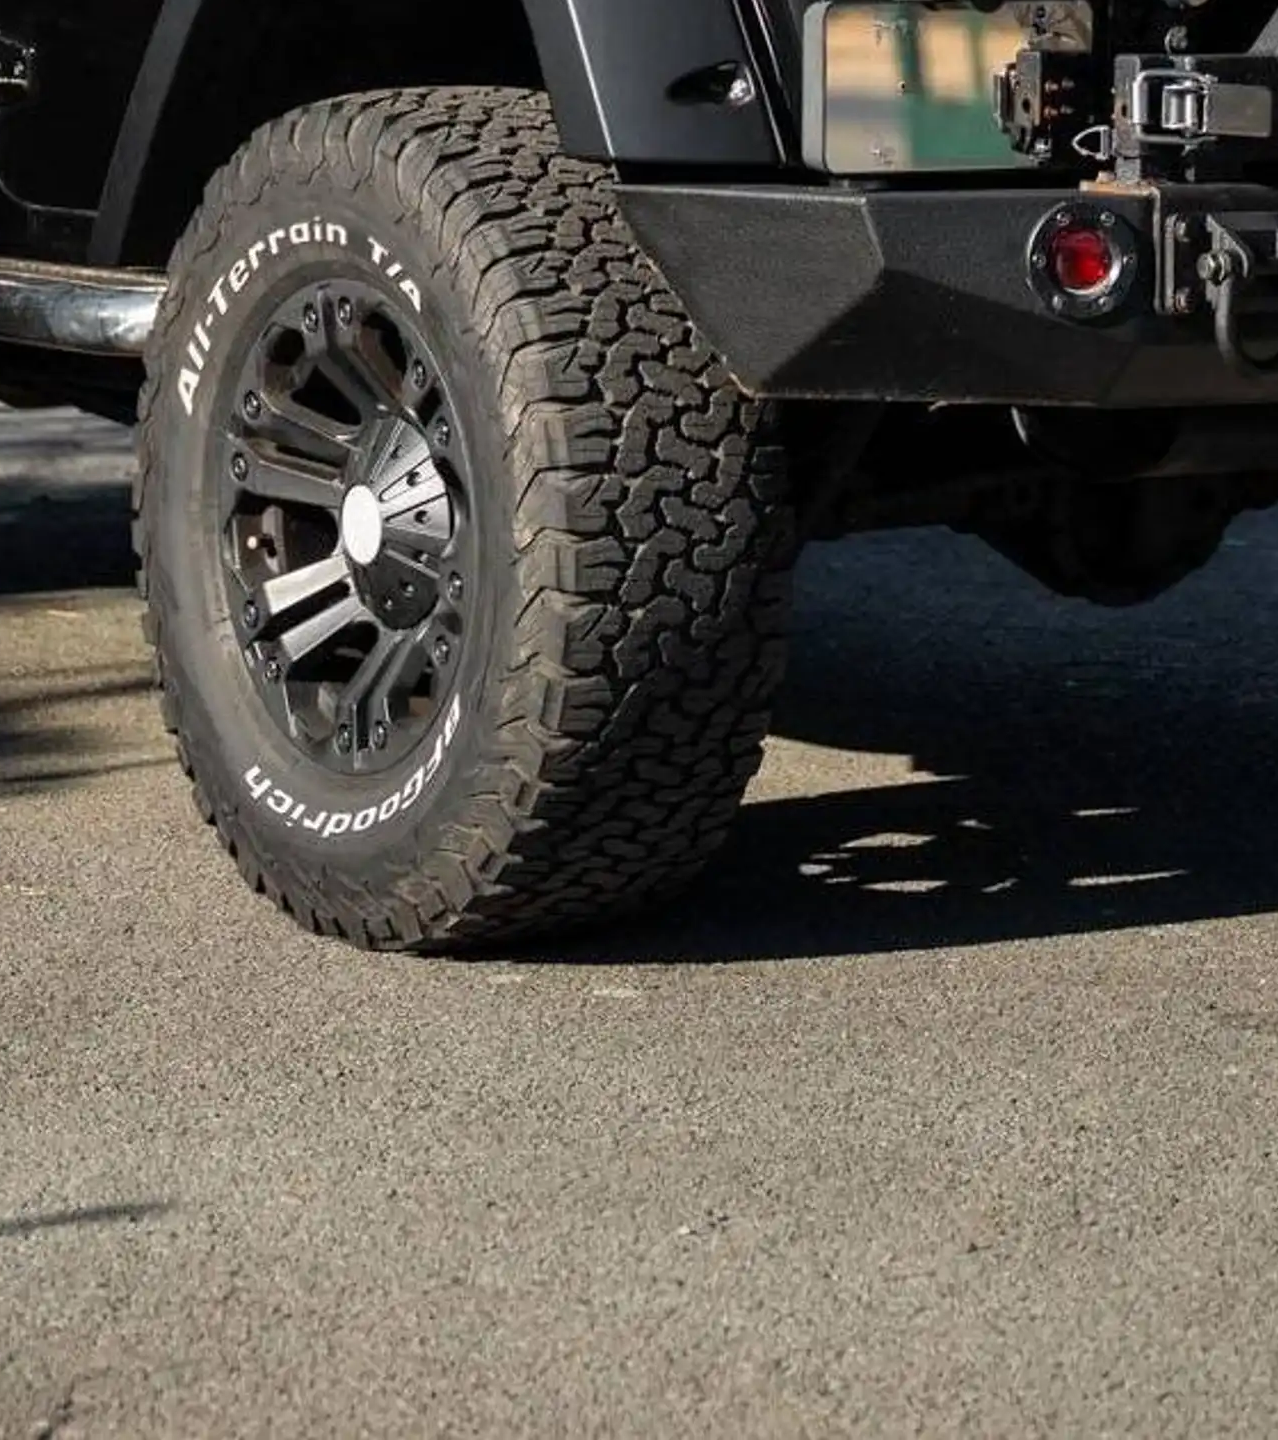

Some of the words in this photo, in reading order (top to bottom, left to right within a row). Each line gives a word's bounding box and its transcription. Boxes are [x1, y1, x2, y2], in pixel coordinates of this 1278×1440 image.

[178, 216, 348, 416] All-Terrain
[367, 236, 422, 314] T/A
[242, 692, 461, 838] BFGoodrich
